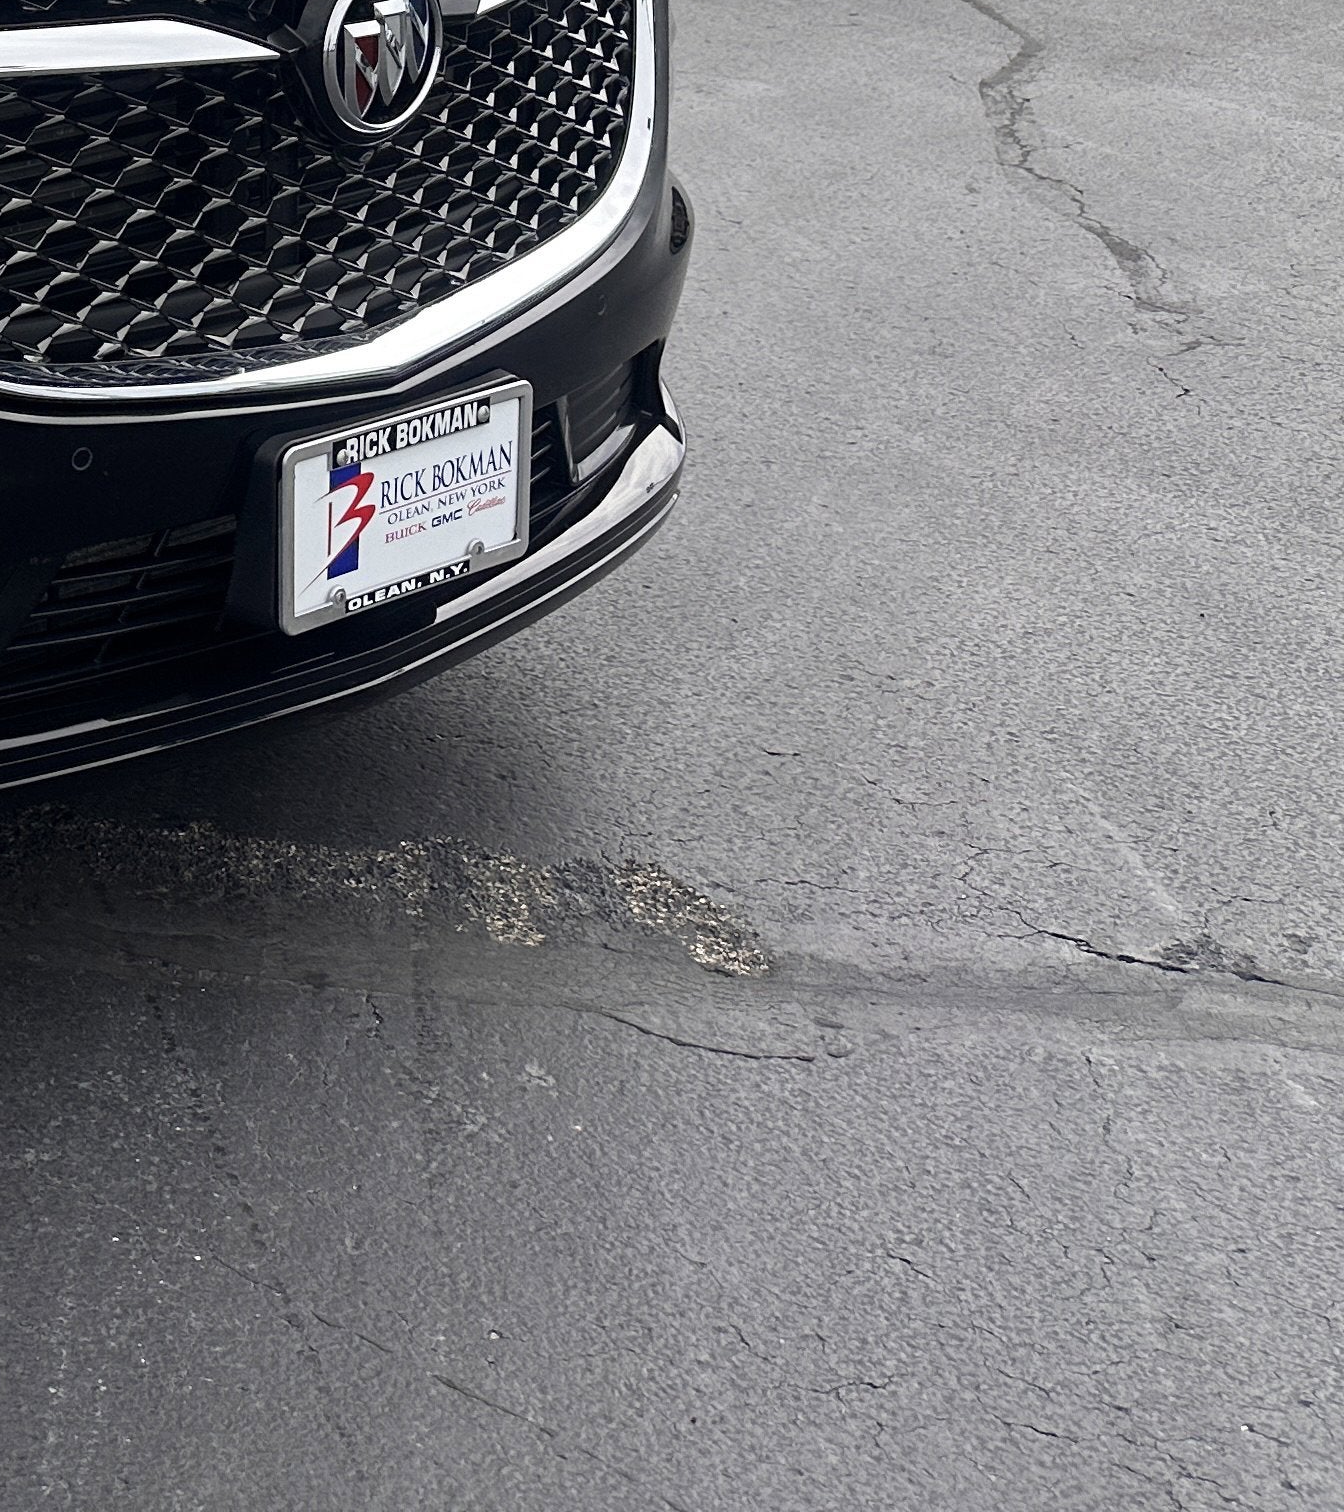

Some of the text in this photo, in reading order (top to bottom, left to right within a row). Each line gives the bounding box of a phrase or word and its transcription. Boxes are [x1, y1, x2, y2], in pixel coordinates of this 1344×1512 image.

[345, 400, 479, 464] RICK BOKMAN
[380, 440, 513, 509] RICK BOKMAN
[437, 488, 468, 509] NEW
[470, 476, 506, 498] YORK
[384, 521, 428, 544] BUICK
[431, 508, 463, 528] GMC
[347, 562, 468, 611] OLEAN, N.Y.
